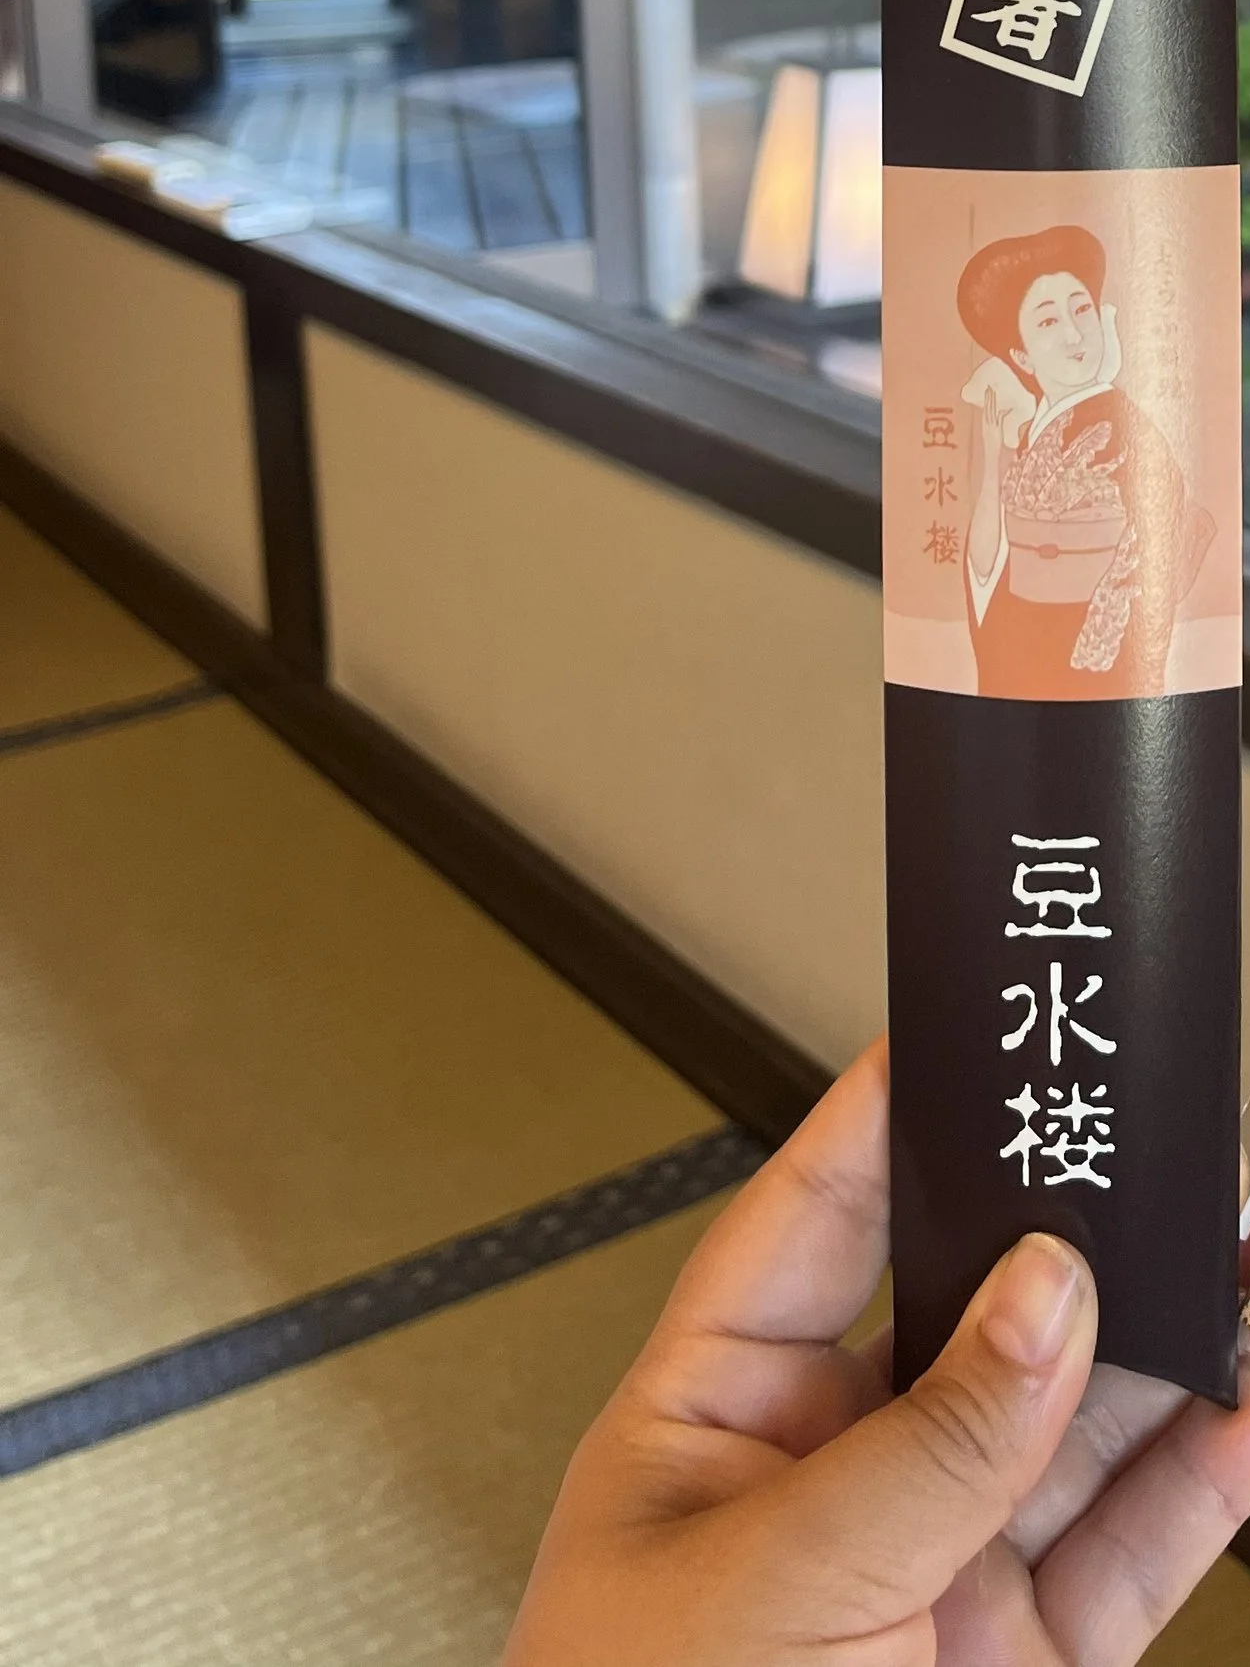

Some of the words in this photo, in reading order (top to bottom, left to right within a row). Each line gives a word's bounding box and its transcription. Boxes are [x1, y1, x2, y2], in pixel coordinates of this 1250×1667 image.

[922, 406, 961, 565] 豆水楼
[999, 833, 1118, 1190] 豆水楼
